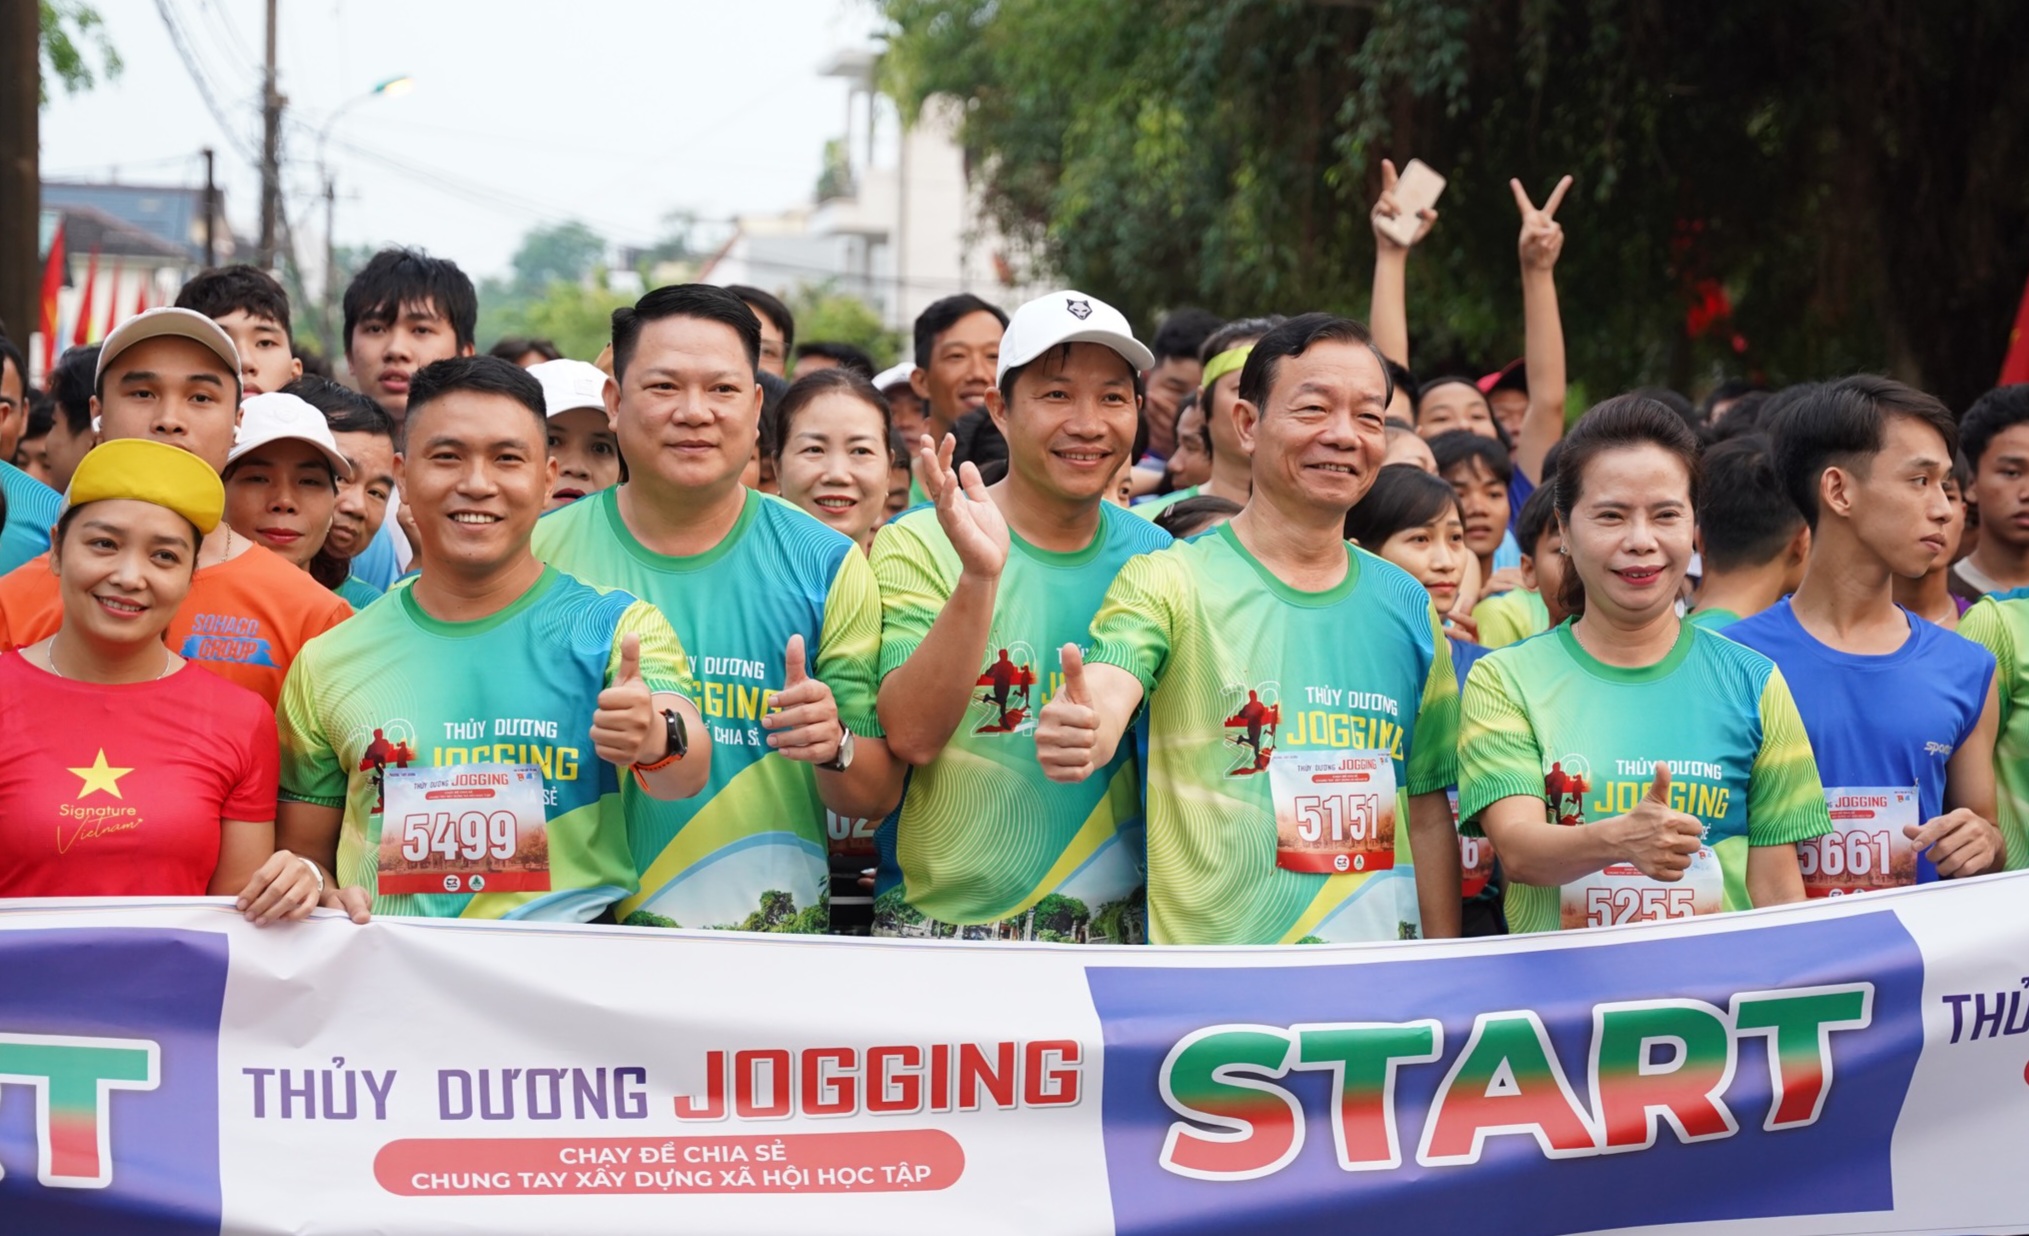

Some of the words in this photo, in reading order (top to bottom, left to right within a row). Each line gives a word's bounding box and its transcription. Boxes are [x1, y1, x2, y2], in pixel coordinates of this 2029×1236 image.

[191, 613, 259, 637] SOHACO
[199, 638, 258, 661] GROUP
[705, 656, 765, 680] DƯƠNG
[1305, 684, 1342, 706] THỦY
[1348, 691, 1398, 716] DƯƠNG
[443, 718, 487, 740] THỦY
[494, 718, 558, 739] DƯƠNG
[1338, 759, 1377, 770] JOGGING
[1616, 757, 1657, 776] THỦY
[1670, 760, 1722, 780] DƯƠNG
[451, 773, 509, 787] JOGGING
[59, 804, 137, 819] Signature
[1834, 796, 1888, 808] JOGGING
[1294, 794, 1379, 842] 5151
[57, 814, 139, 854] Vietnam
[401, 810, 518, 862] 5499
[1797, 829, 1891, 876] 5661
[1586, 888, 1696, 928] 5255
[242, 1056, 398, 1120] THỦY
[437, 1065, 649, 1121] DƯƠNG
[673, 1038, 1084, 1123] JOGGING
[1159, 981, 1875, 1182] START
[559, 1146, 632, 1168] CHẠY
[638, 1141, 676, 1164] ĐỂ
[683, 1145, 749, 1163] CHIA
[755, 1138, 786, 1163] SẺ
[411, 1171, 511, 1190] CHUNG
[517, 1171, 569, 1188] TAY
[574, 1165, 628, 1188] XÂY
[635, 1169, 714, 1191] DỰNG
[720, 1165, 757, 1187] XÃ
[763, 1165, 810, 1190] HỘI
[817, 1167, 875, 1188] HỌC
[880, 1161, 932, 1186] TẬP
